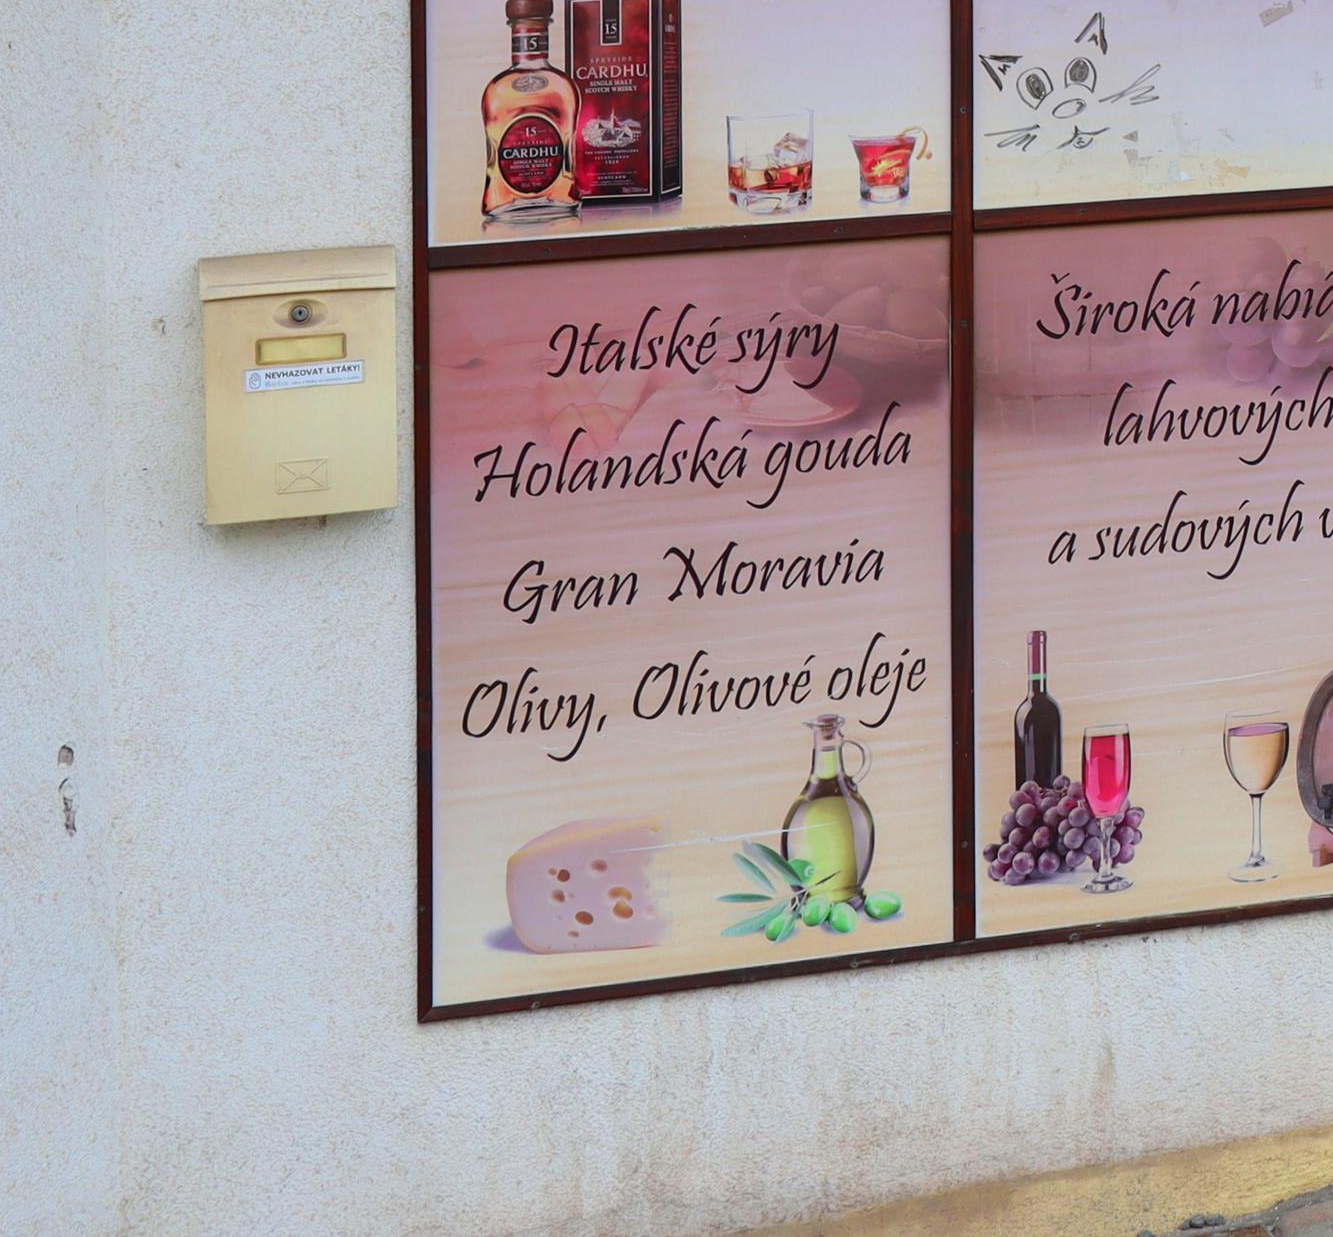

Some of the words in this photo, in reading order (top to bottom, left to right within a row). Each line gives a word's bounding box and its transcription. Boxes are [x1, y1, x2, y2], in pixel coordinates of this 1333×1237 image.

[522, 38, 537, 50] 15
[604, 23, 617, 35] 15
[576, 64, 646, 79] CARDHU
[503, 148, 558, 158] CARDHU
[525, 127, 537, 137] 15
[1036, 268, 1201, 339] Široká
[546, 303, 722, 378] Italské
[728, 312, 839, 393] sýry
[265, 368, 323, 379] NEVHAZOVAT
[327, 364, 360, 374] LETÁKY!
[474, 416, 747, 502] Holandská
[744, 402, 912, 508] gouda
[1048, 531, 1077, 565] a
[1088, 479, 1305, 580] sudových
[503, 560, 639, 625] Gran
[663, 538, 884, 602] Moravia
[462, 667, 607, 762] Olivy,
[633, 650, 816, 720] Olivové
[822, 632, 927, 733] oleje
